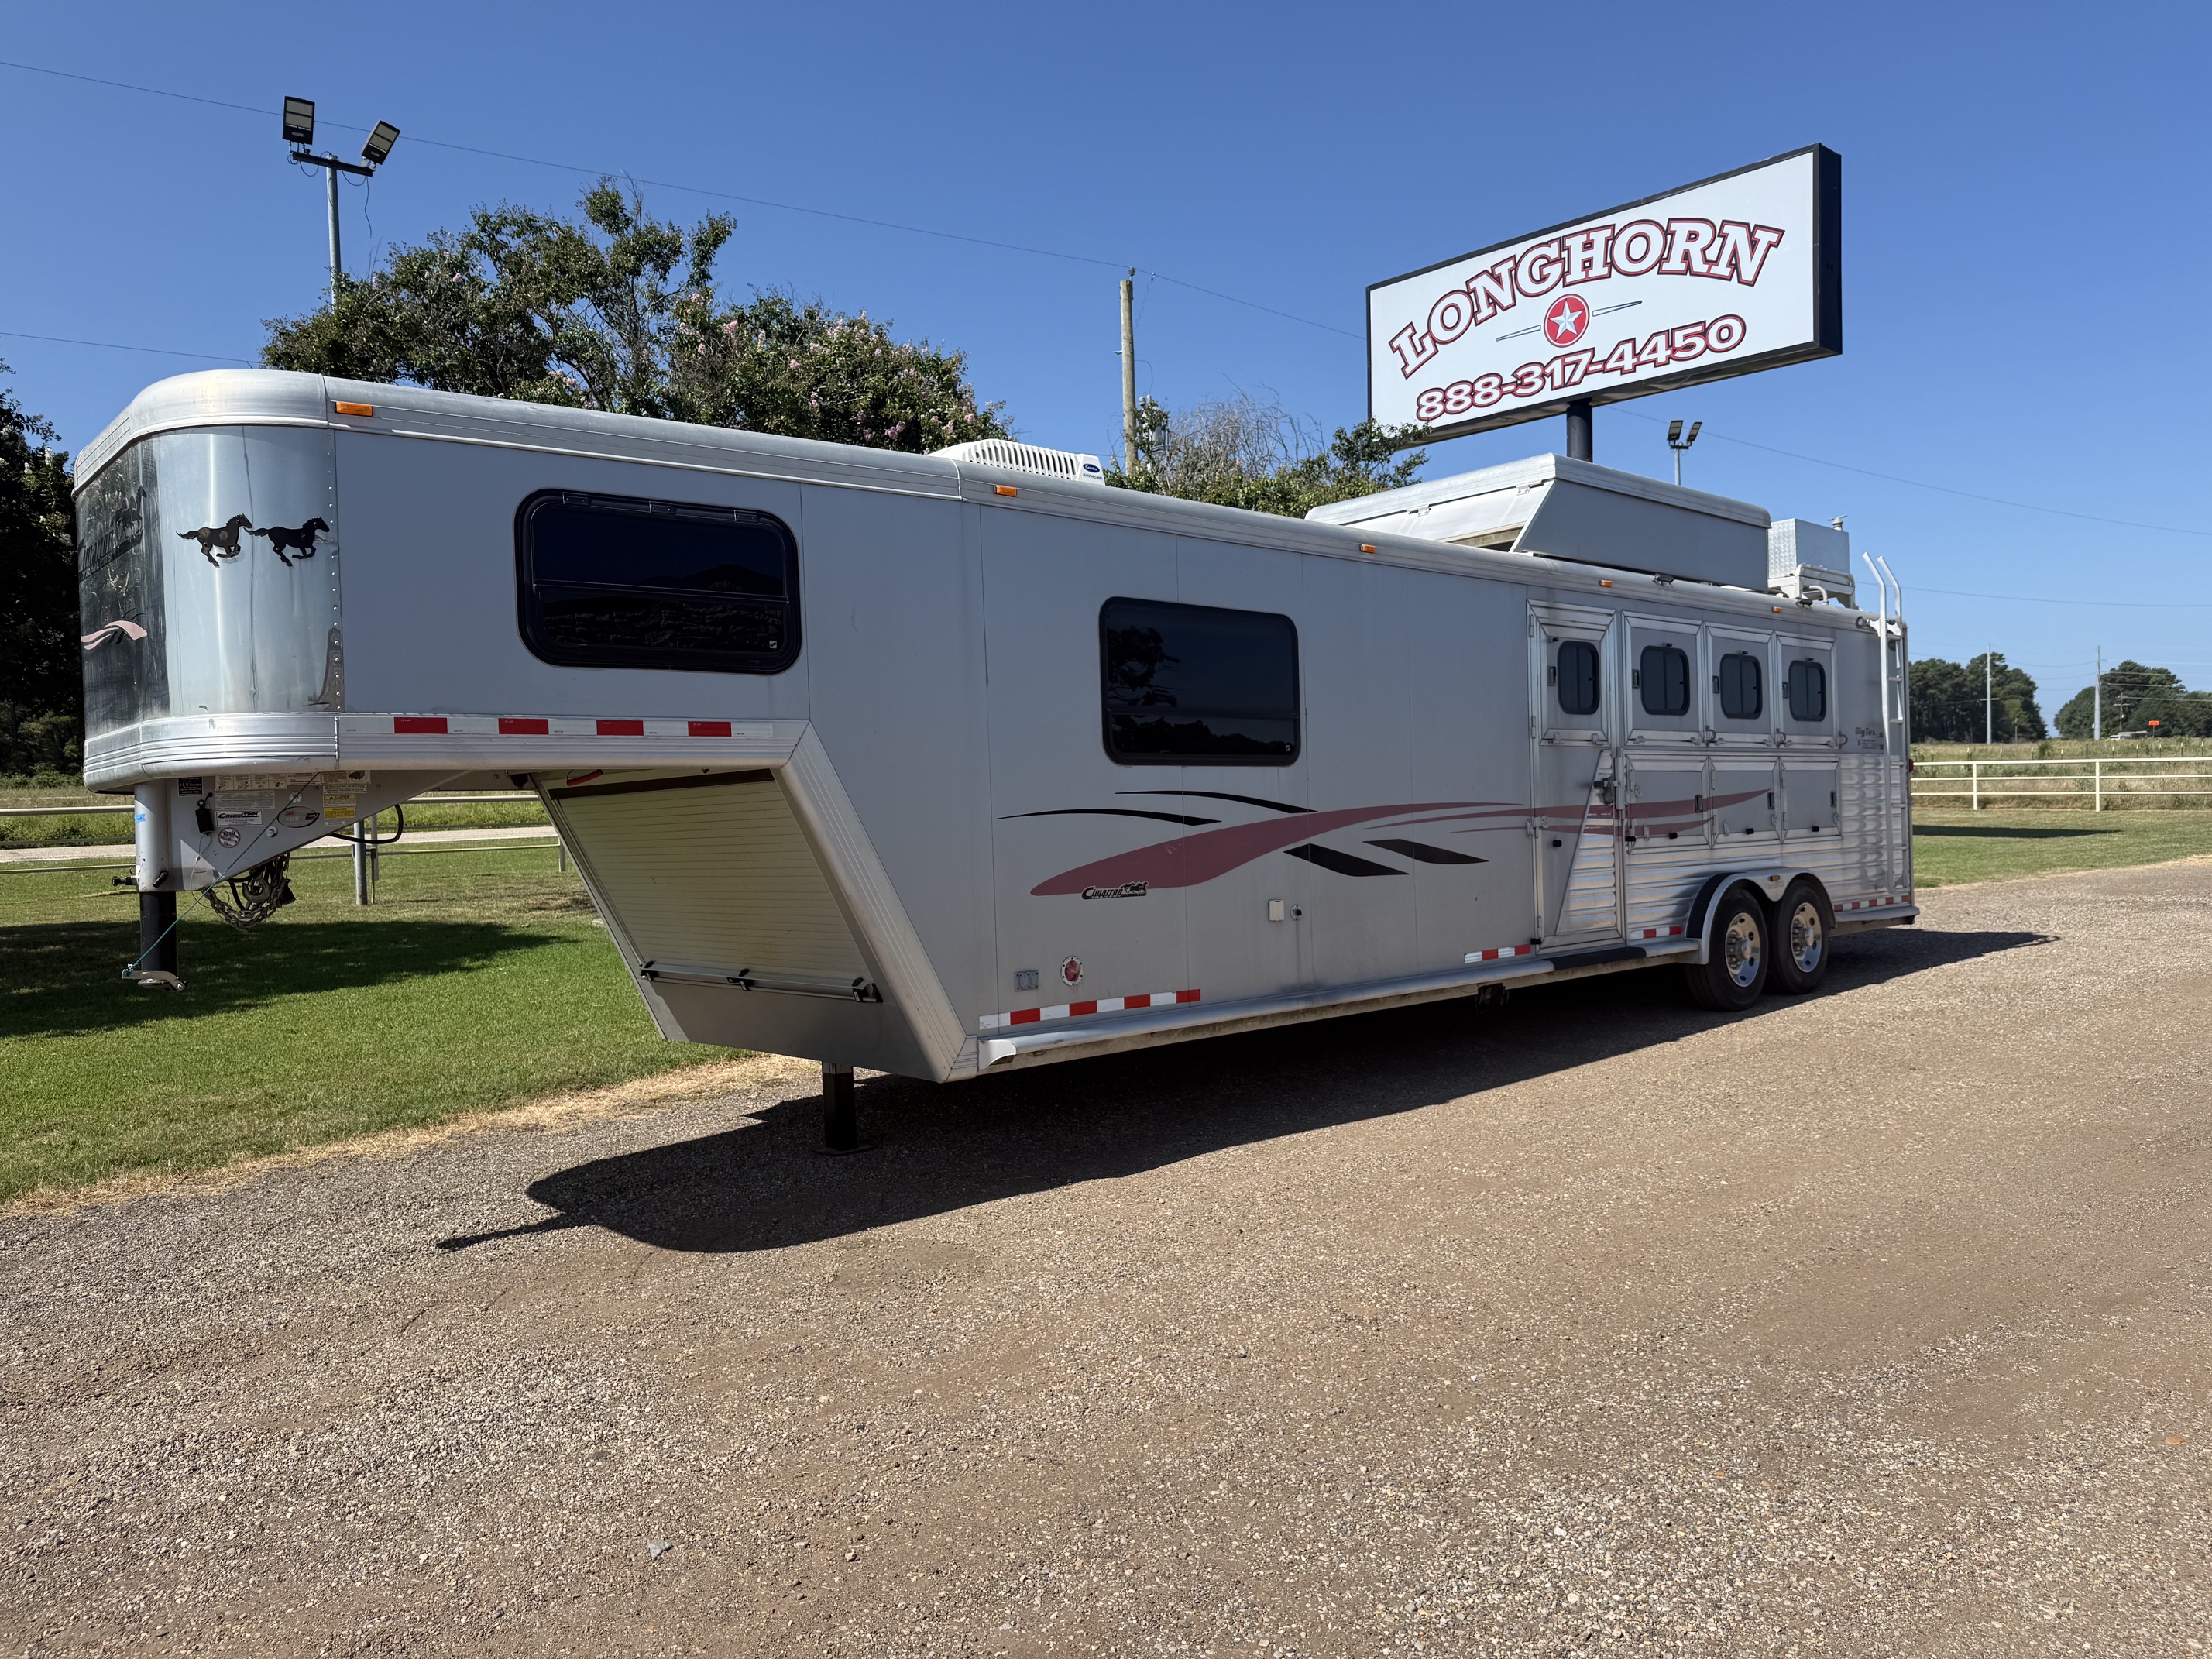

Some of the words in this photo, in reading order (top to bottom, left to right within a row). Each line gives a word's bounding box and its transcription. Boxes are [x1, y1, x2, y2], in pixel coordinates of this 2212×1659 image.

[1389, 218, 1785, 379] LONGHORN
[1417, 314, 1747, 421] 888-317-4450
[1082, 887, 1123, 899] Cimarron
